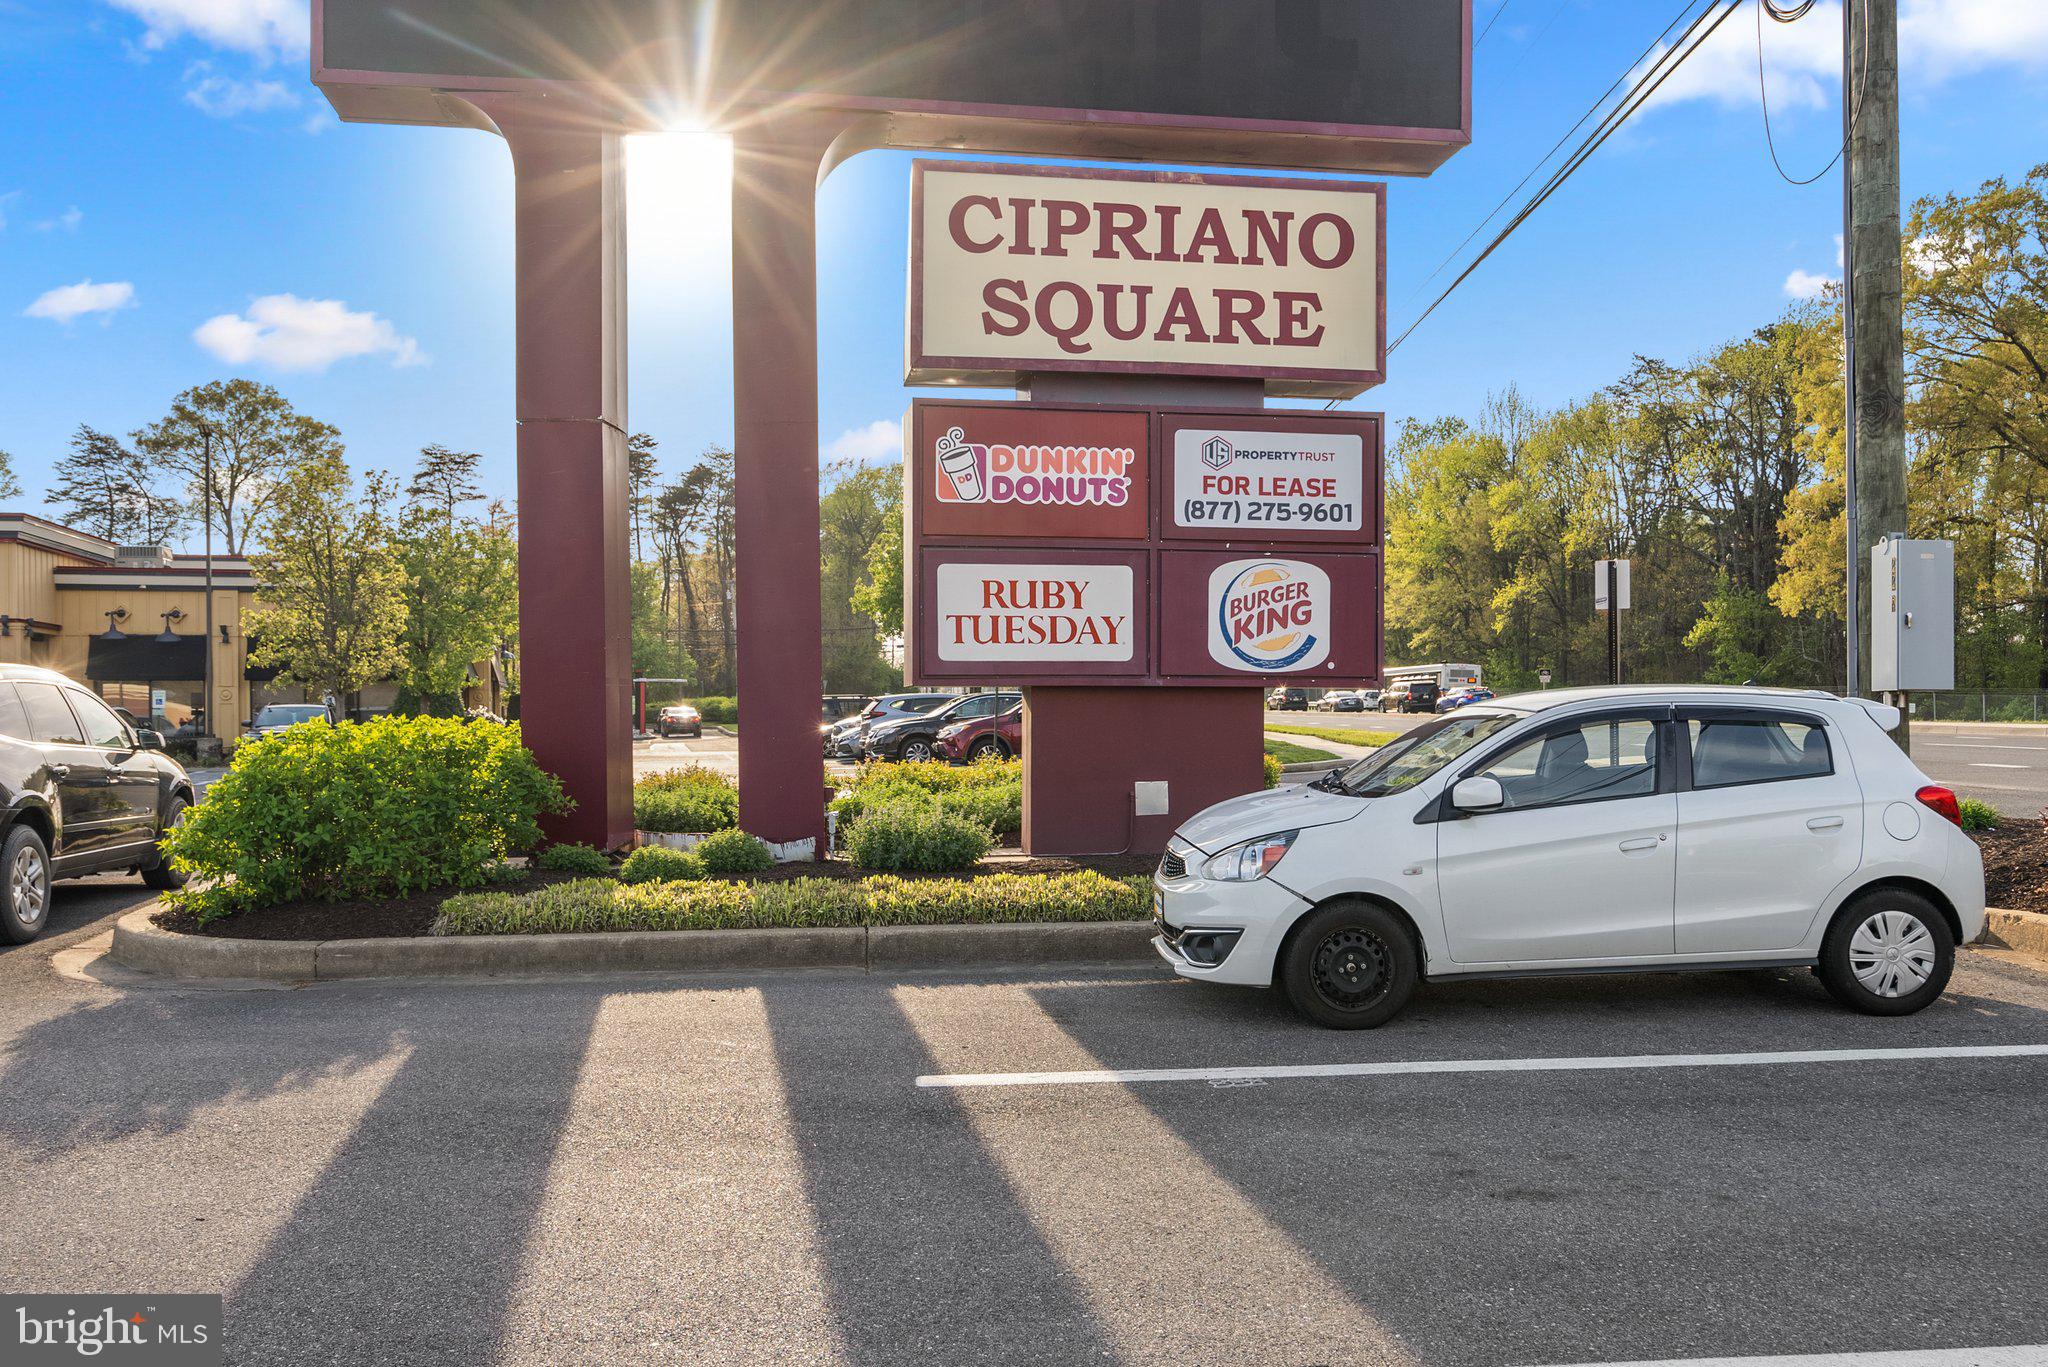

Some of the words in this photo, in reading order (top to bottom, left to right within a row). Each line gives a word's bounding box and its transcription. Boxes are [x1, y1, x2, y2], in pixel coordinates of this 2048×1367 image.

[948, 194, 1355, 269] CIPRIANO
[981, 278, 1326, 354] SQUARE
[991, 447, 1133, 475] DUNKIN'
[957, 472, 973, 484] DD
[991, 475, 1126, 504] DONUTS
[1202, 475, 1250, 496] FOR
[1258, 477, 1337, 498] LEASE
[1184, 499, 1241, 523] (877)
[1247, 501, 1352, 522] 275-9601
[981, 579, 1090, 610] RUBY
[1230, 581, 1310, 619] BURGER
[945, 614, 1126, 645] TUESDAY
[1233, 599, 1312, 646] KING
